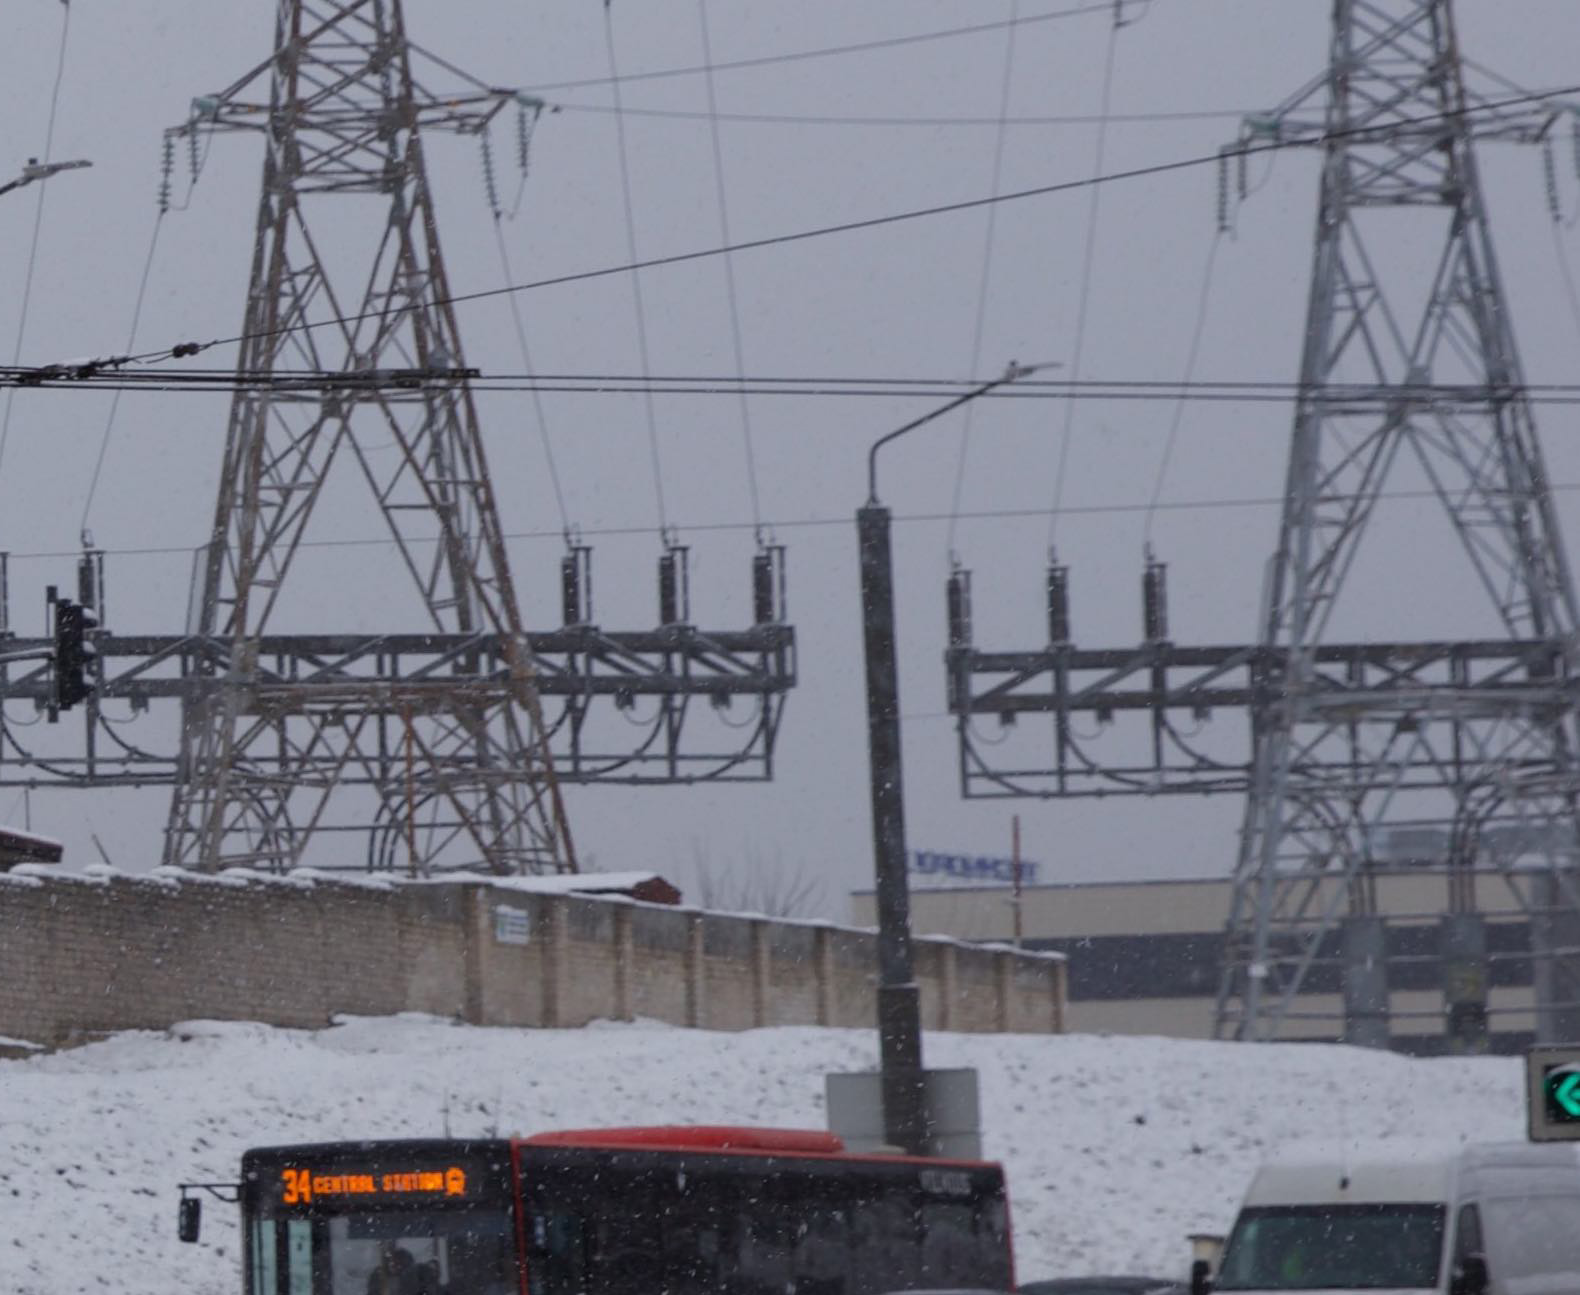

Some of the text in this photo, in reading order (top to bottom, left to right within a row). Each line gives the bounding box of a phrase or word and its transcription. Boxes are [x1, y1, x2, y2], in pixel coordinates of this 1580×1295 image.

[283, 1169, 444, 1203] 34 CENTRAL STATION
